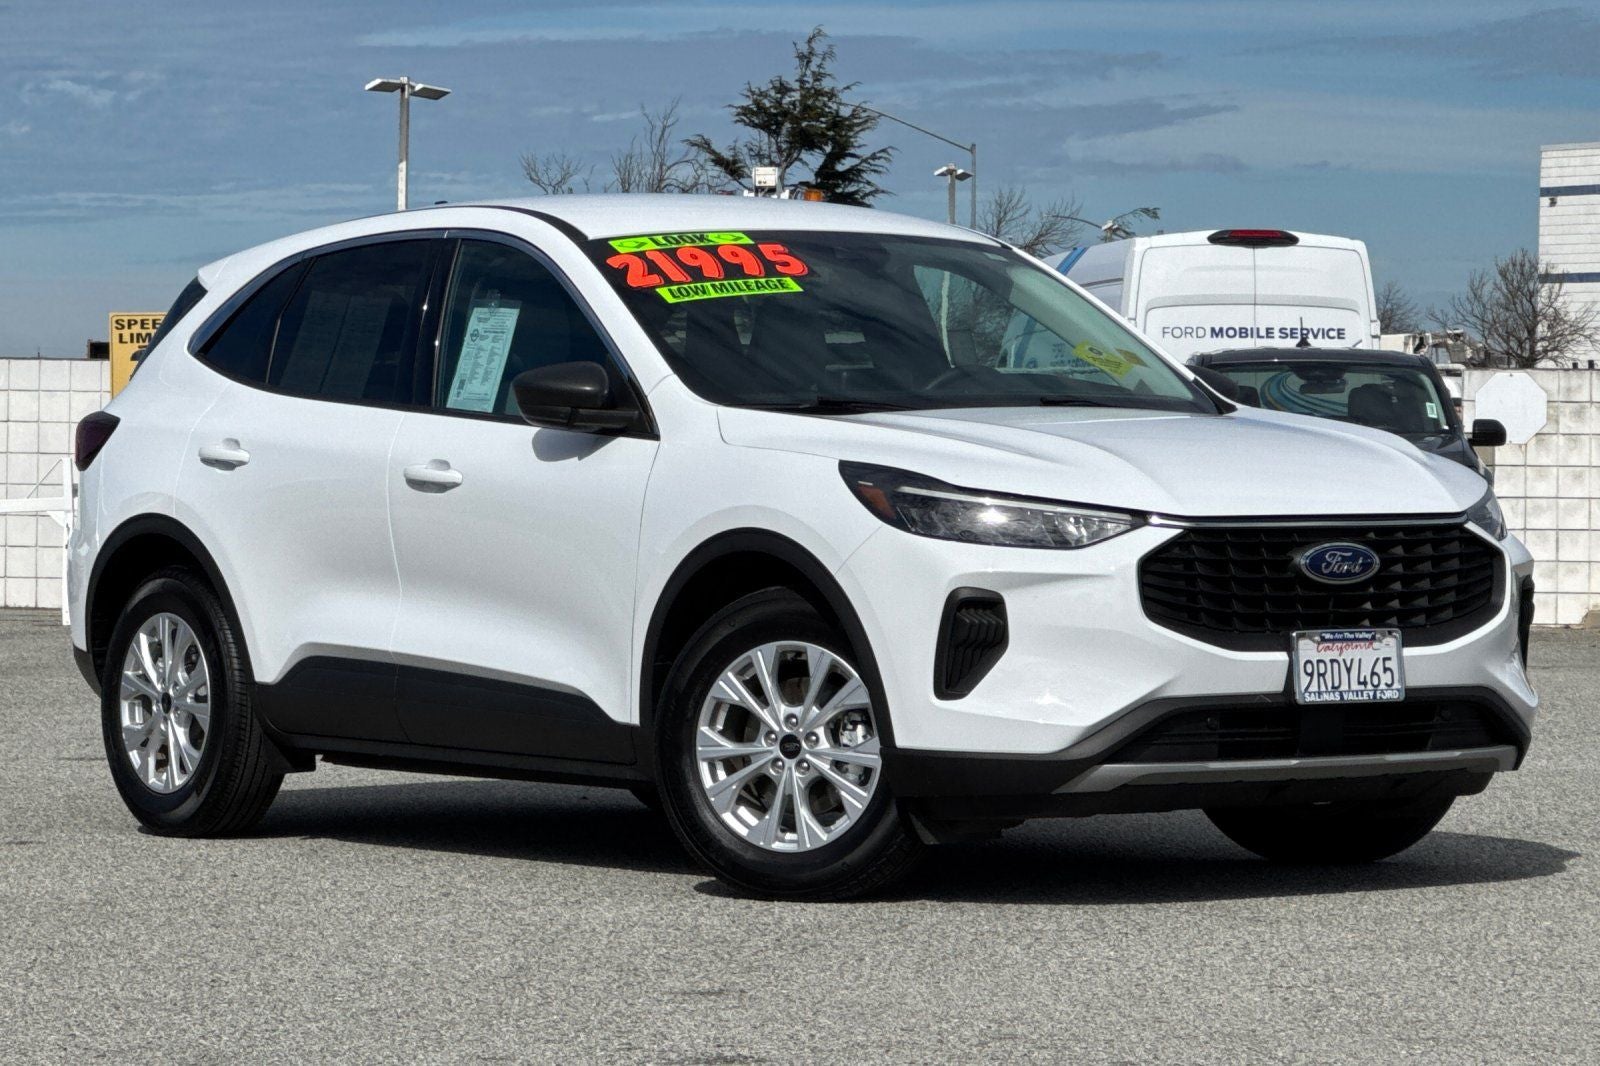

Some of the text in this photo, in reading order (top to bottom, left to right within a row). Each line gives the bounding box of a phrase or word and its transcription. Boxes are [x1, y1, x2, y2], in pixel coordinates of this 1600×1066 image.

[650, 234, 708, 247] LOOK
[606, 243, 809, 288] 21995
[667, 278, 789, 300] LOW MILEAGE
[115, 318, 162, 330] SPEE
[118, 332, 153, 344] LIM
[1161, 326, 1346, 340] FORD MOBILE SERVICE
[1321, 550, 1364, 574] Ford
[1317, 641, 1376, 656] California
[1303, 657, 1395, 691] 9RDY465
[1304, 689, 1399, 702] SALINAS VALLEY FORD
